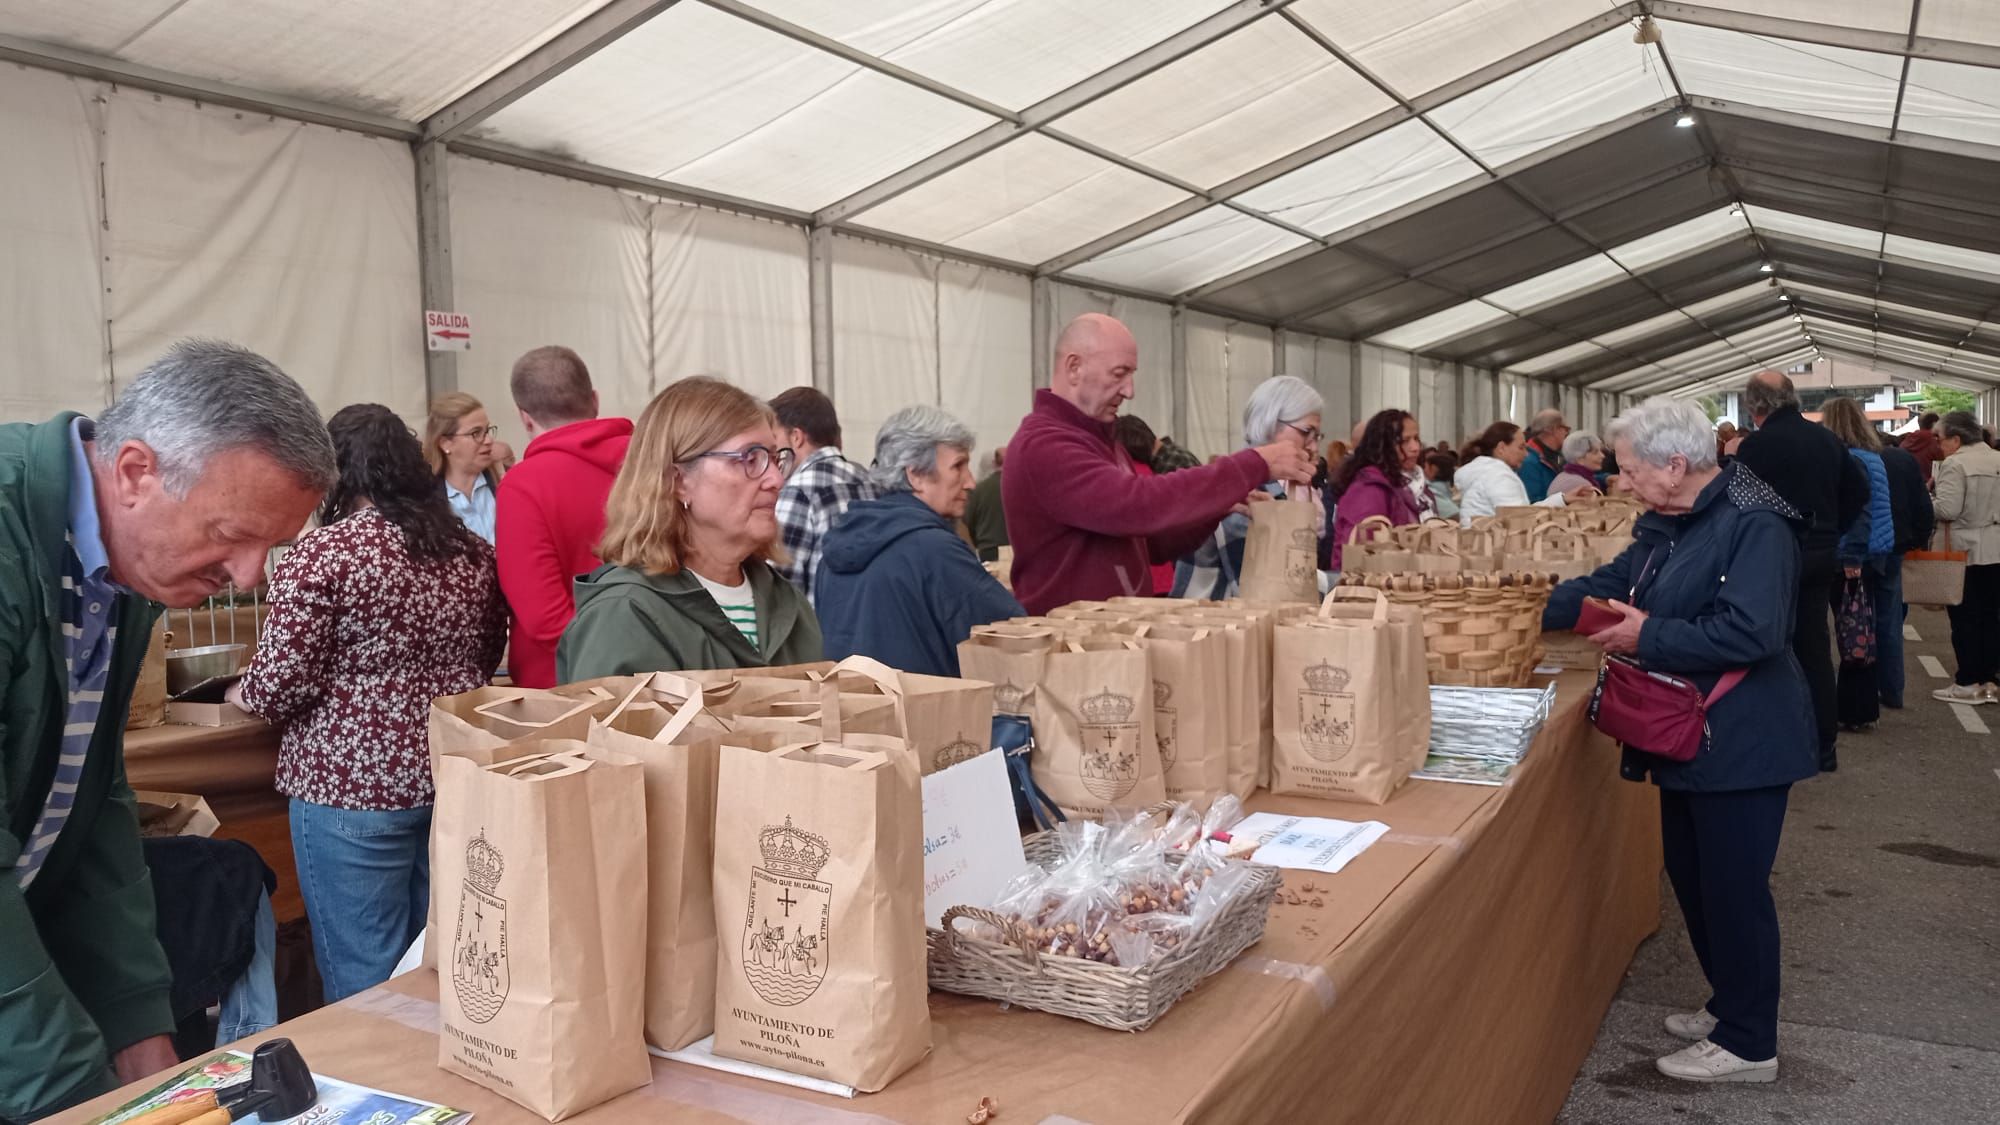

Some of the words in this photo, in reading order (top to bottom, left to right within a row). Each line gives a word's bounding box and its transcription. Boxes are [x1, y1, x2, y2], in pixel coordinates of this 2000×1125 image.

[428, 313, 470, 328] SALIDA
[779, 879, 793, 887] QUE
[794, 881, 801, 889] MI
[802, 883, 829, 894] CABALLO
[732, 1007, 815, 1037] AYUNTAMIENTO
[818, 1027, 835, 1039] DE
[759, 1030, 801, 1048] PILOÑA
[504, 1047, 518, 1060] DE
[740, 1039, 825, 1068] www.ayto-pilona.es
